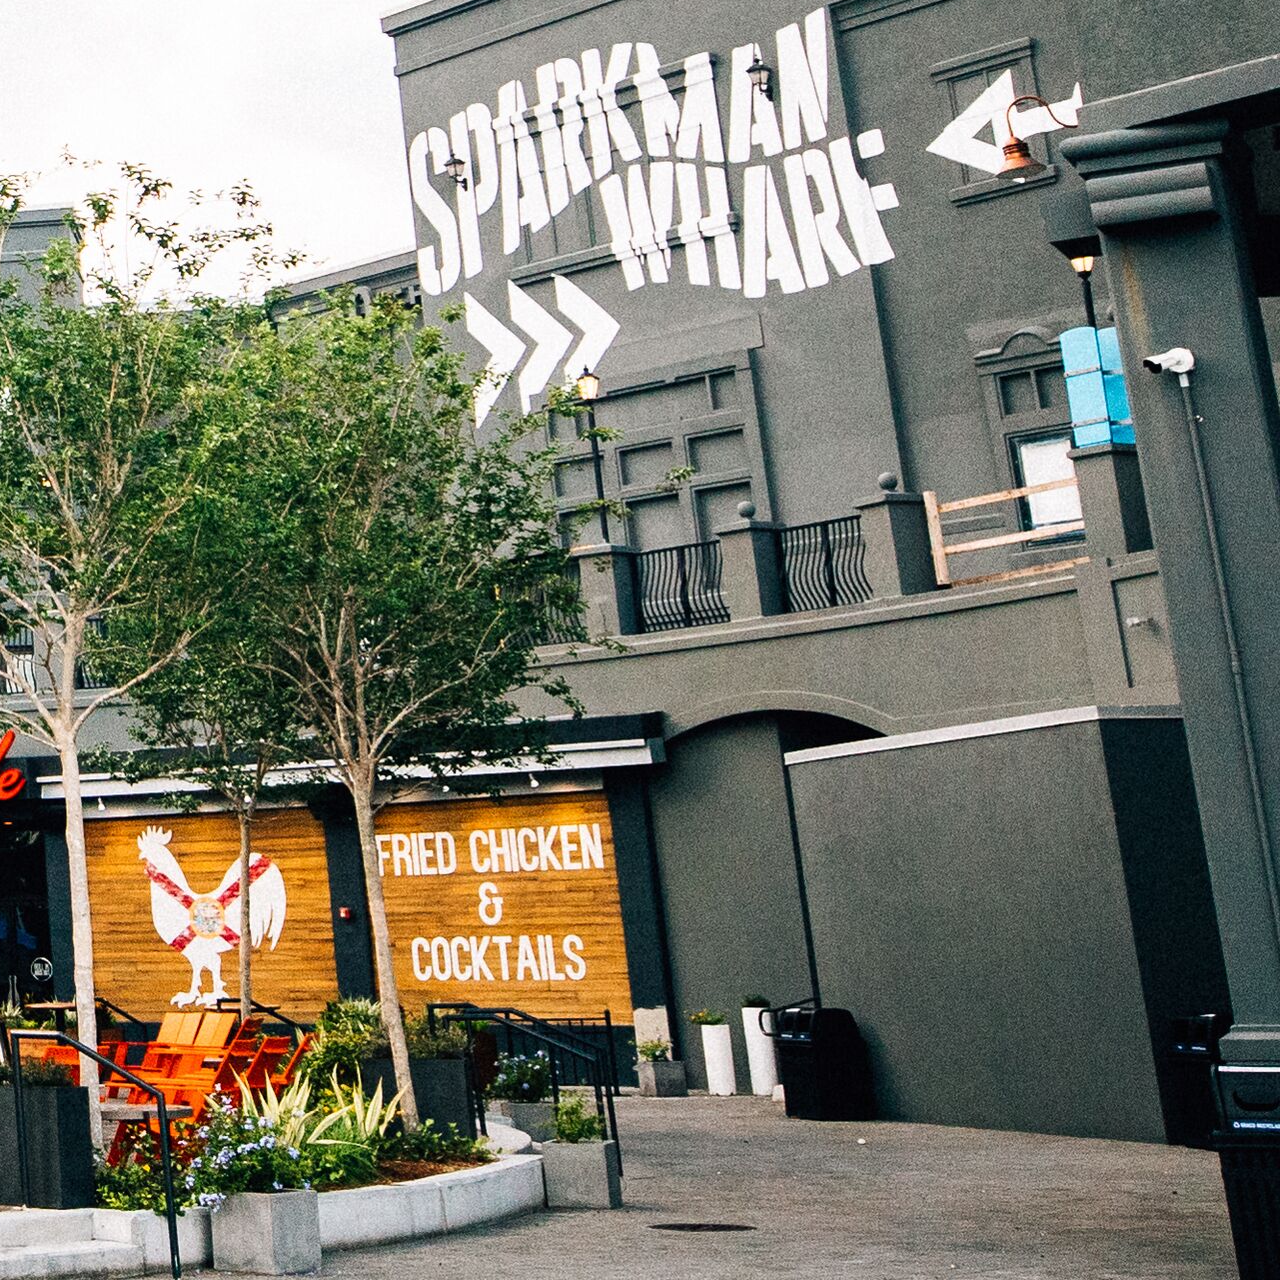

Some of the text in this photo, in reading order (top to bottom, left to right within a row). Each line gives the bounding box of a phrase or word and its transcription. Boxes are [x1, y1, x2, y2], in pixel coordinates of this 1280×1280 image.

[409, 8, 828, 297] SPARKMAN
[599, 128, 899, 299] WHARF
[375, 823, 605, 877] FRIED CHICKEN
[478, 881, 503, 926] &
[411, 934, 587, 981] COCKTAILS
